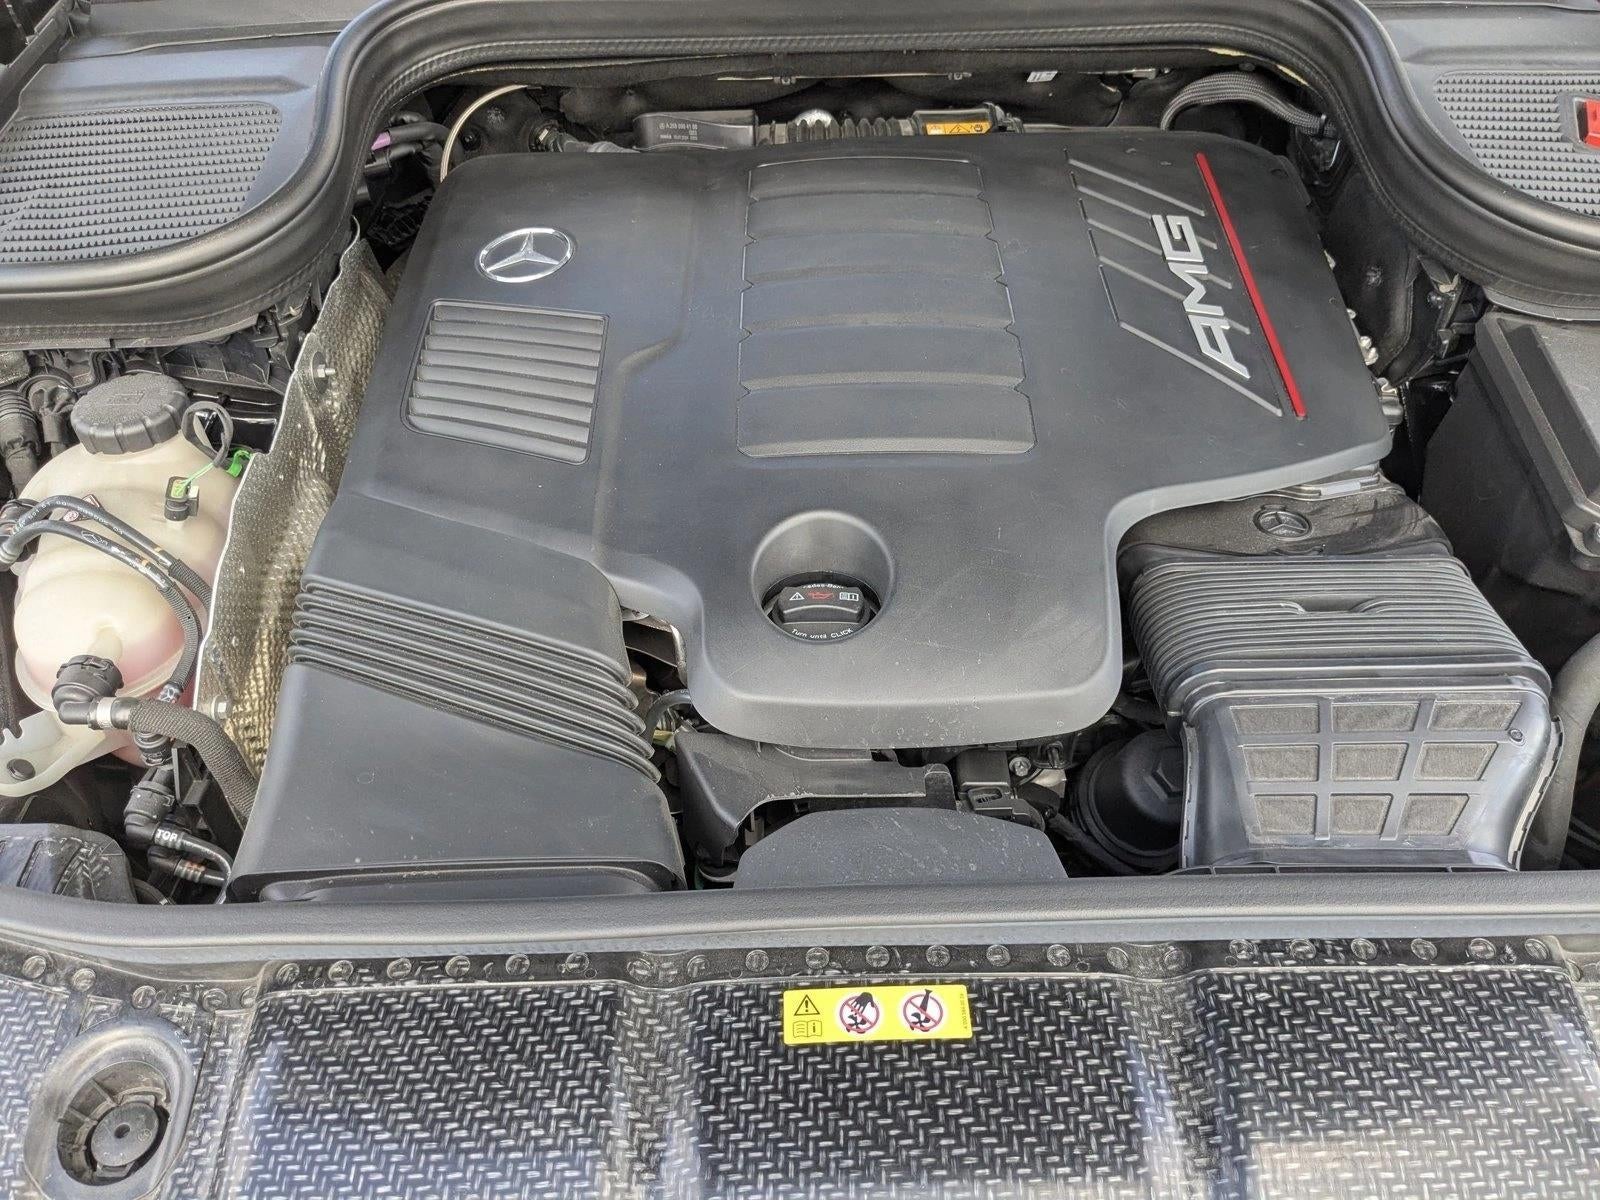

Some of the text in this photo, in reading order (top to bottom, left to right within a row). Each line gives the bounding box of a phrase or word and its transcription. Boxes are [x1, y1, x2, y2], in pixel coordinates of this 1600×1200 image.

[1151, 214, 1251, 379] AMG
[791, 628, 807, 637] Turn
[830, 628, 854, 638] CLICK
